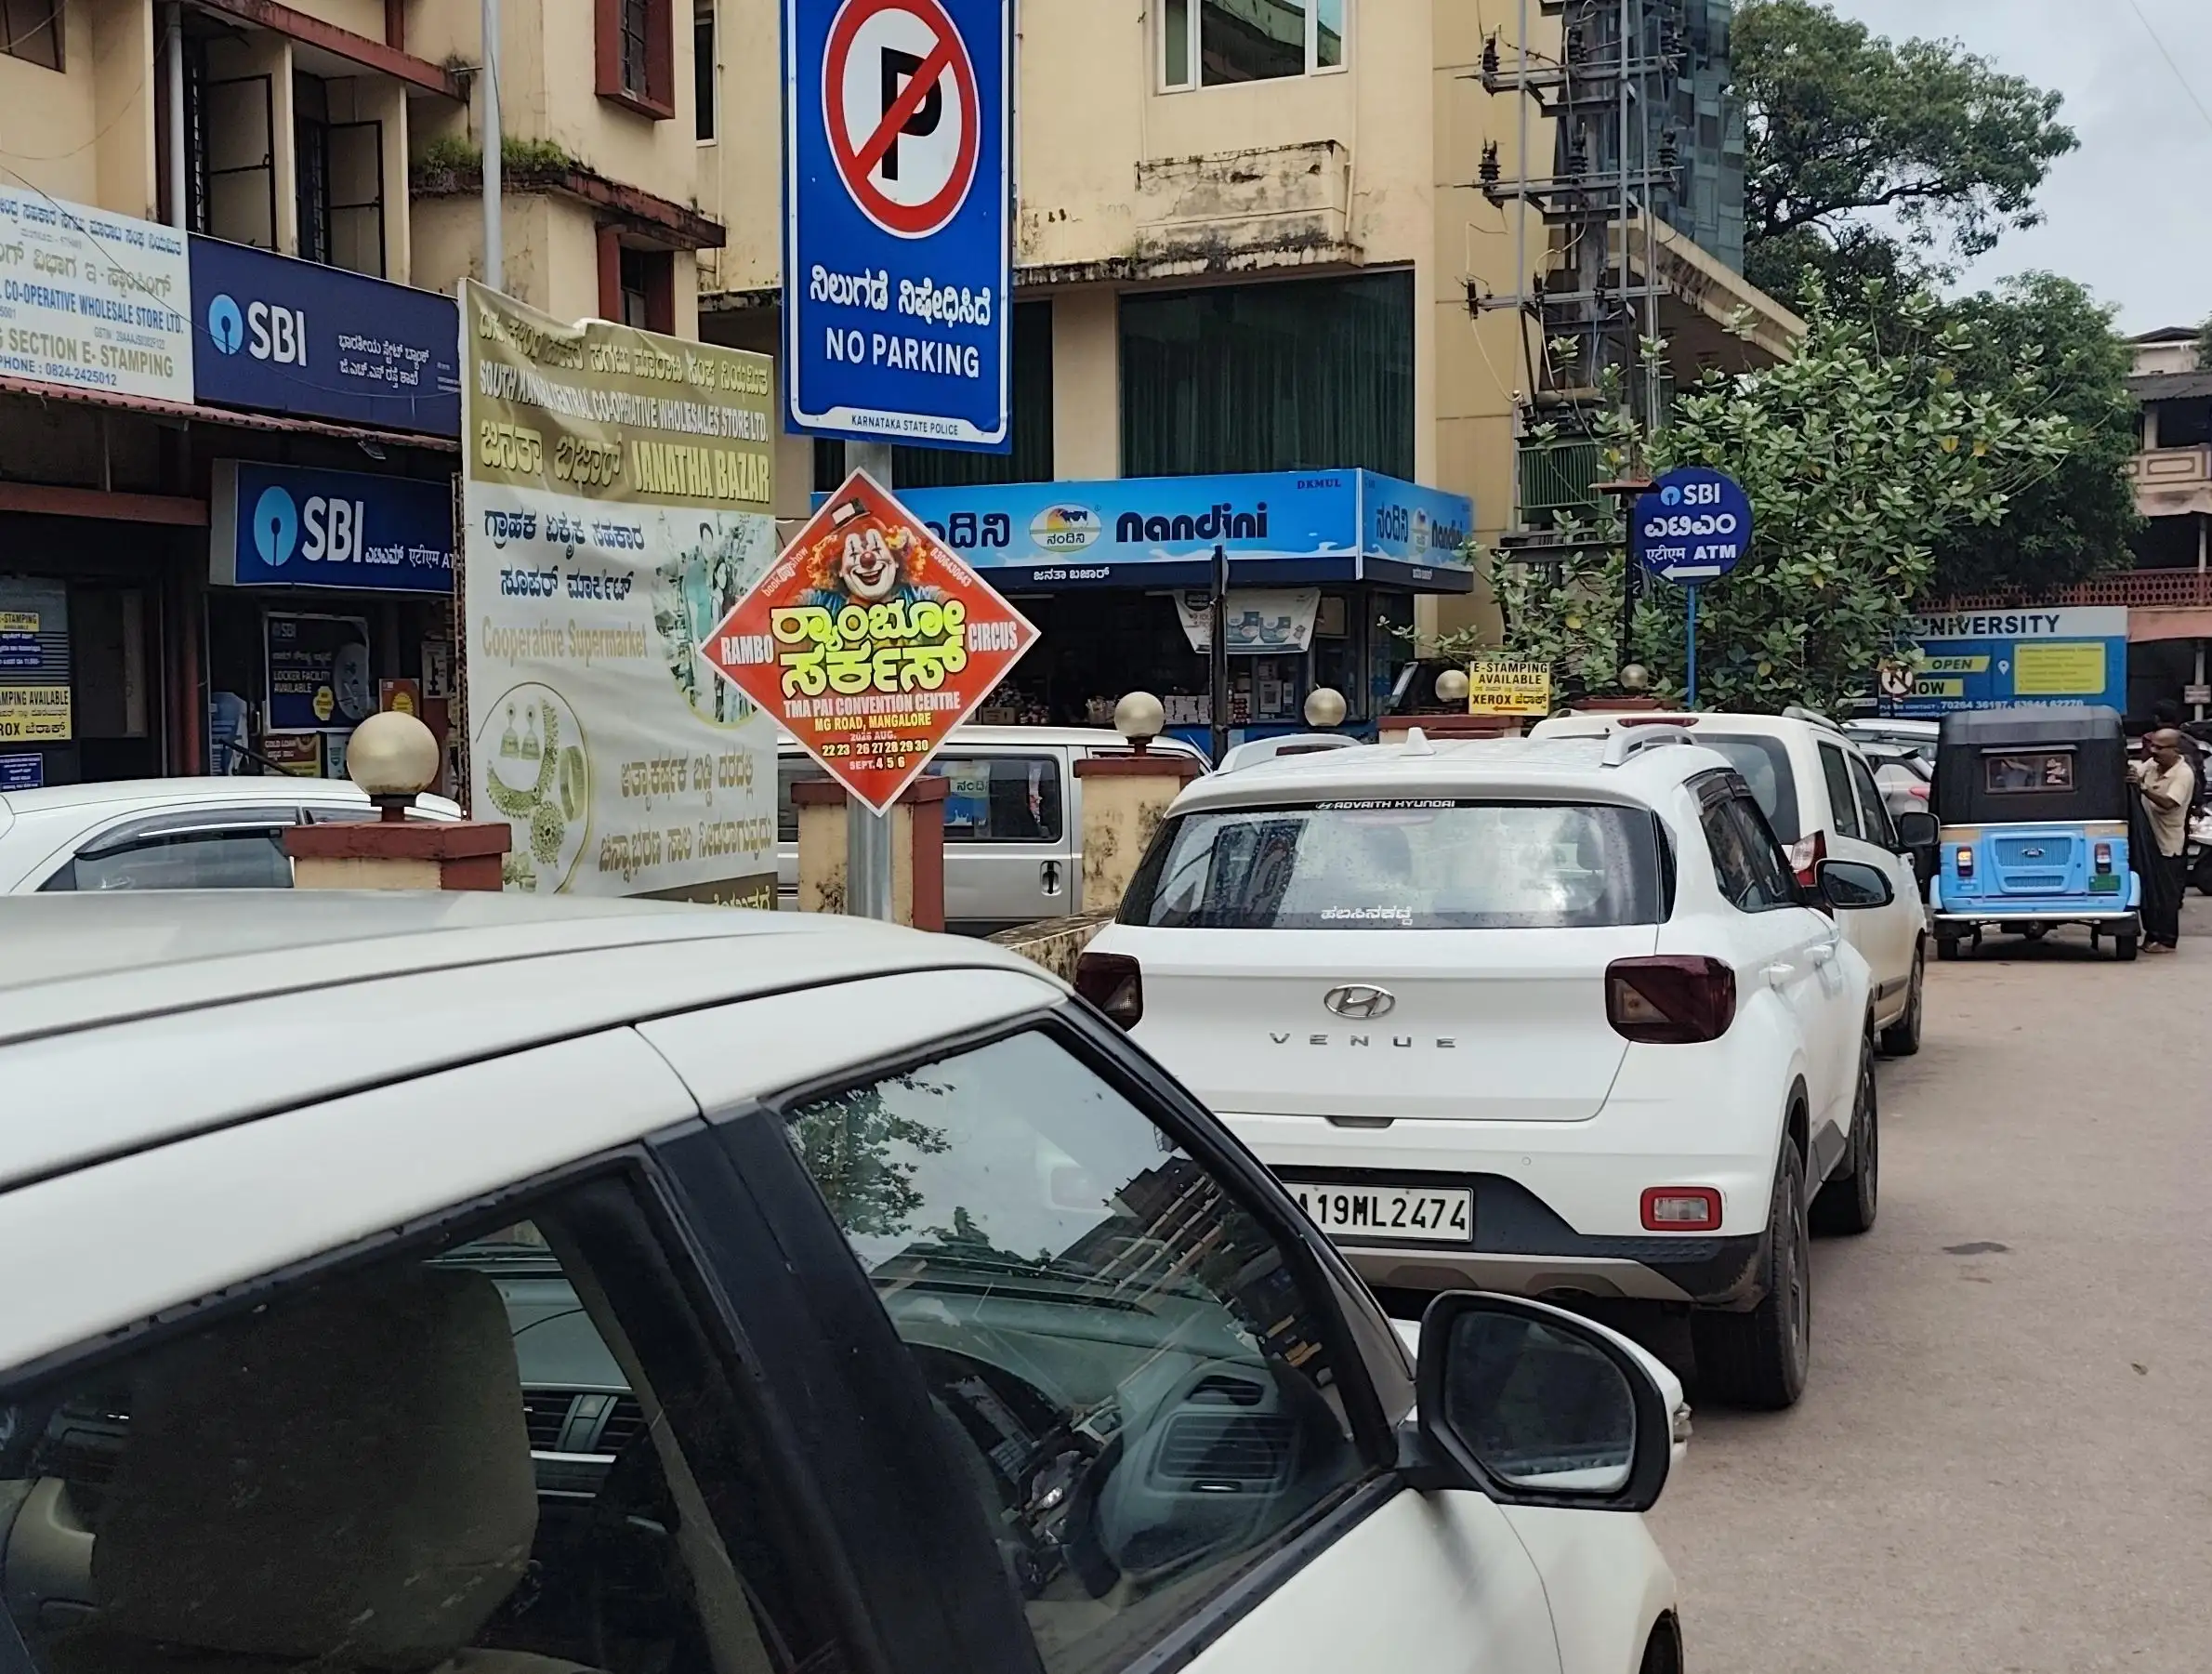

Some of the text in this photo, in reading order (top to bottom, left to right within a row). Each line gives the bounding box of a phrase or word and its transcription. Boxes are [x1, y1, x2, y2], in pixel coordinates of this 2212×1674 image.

[5, 281, 184, 334] CO-OPERATIVE WHOLESALE STORE LTD.
[810, 264, 991, 328] ನಿಲುಗಡೆ ನಿಷೇಧಿಸಿದೆ
[248, 302, 307, 367] SBI
[338, 335, 381, 354] ಭಾರತೀಯ
[8, 327, 77, 362] SECTION
[100, 344, 174, 378] STAMPING
[826, 327, 979, 378] NO PARKING
[46, 362, 117, 386] 0824-2425012
[480, 360, 517, 401] SOUTH
[658, 399, 719, 437] WHOLESALES
[721, 407, 749, 440] STORE
[751, 412, 769, 442] LTD.
[851, 415, 958, 435] KARNATAKA STATE POLICE
[481, 418, 543, 477] ಜನತಾ
[632, 440, 770, 504] JANATHA BAZAR
[1297, 478, 1341, 490] DKMUL
[1683, 483, 1720, 506] SBI
[301, 495, 363, 563] SBI
[484, 507, 537, 549] ಗ್ರಾಹಕ
[1047, 534, 1085, 545] ನಂದಿನಿ
[408, 544, 440, 569] एटीएम
[441, 554, 461, 569] AT
[1646, 543, 1686, 564] एटीएम
[1693, 545, 1736, 560] ATM
[500, 562, 558, 598] ಸೂಪರ್
[1034, 567, 1110, 580] ಜನತಾ ಬಜಾರ್
[481, 615, 649, 666] Cooperative Supermarket
[968, 621, 1018, 652] CIRCUS
[720, 635, 774, 666] RAMBO
[780, 639, 968, 699] ಸರ್ಕಸ್
[1474, 663, 1547, 673] E-STAMPING
[1932, 659, 1973, 669] OPEN
[1479, 675, 1542, 684] AVAILABLE
[30, 691, 69, 705] AVAILABLE
[783, 692, 961, 718] TMA PAI CONVENTION CENTRE
[1473, 694, 1511, 705] XEROX
[814, 713, 931, 732] MG ROAD, MANGALORE
[874, 731, 897, 741] AUG.
[822, 740, 928, 757] 22 23 26 27 28 29 30
[849, 757, 905, 771] SEPT. 4 5 6
[667, 826, 692, 863] ಸಾಲ
[1270, 1033, 1456, 1048] VENUE
